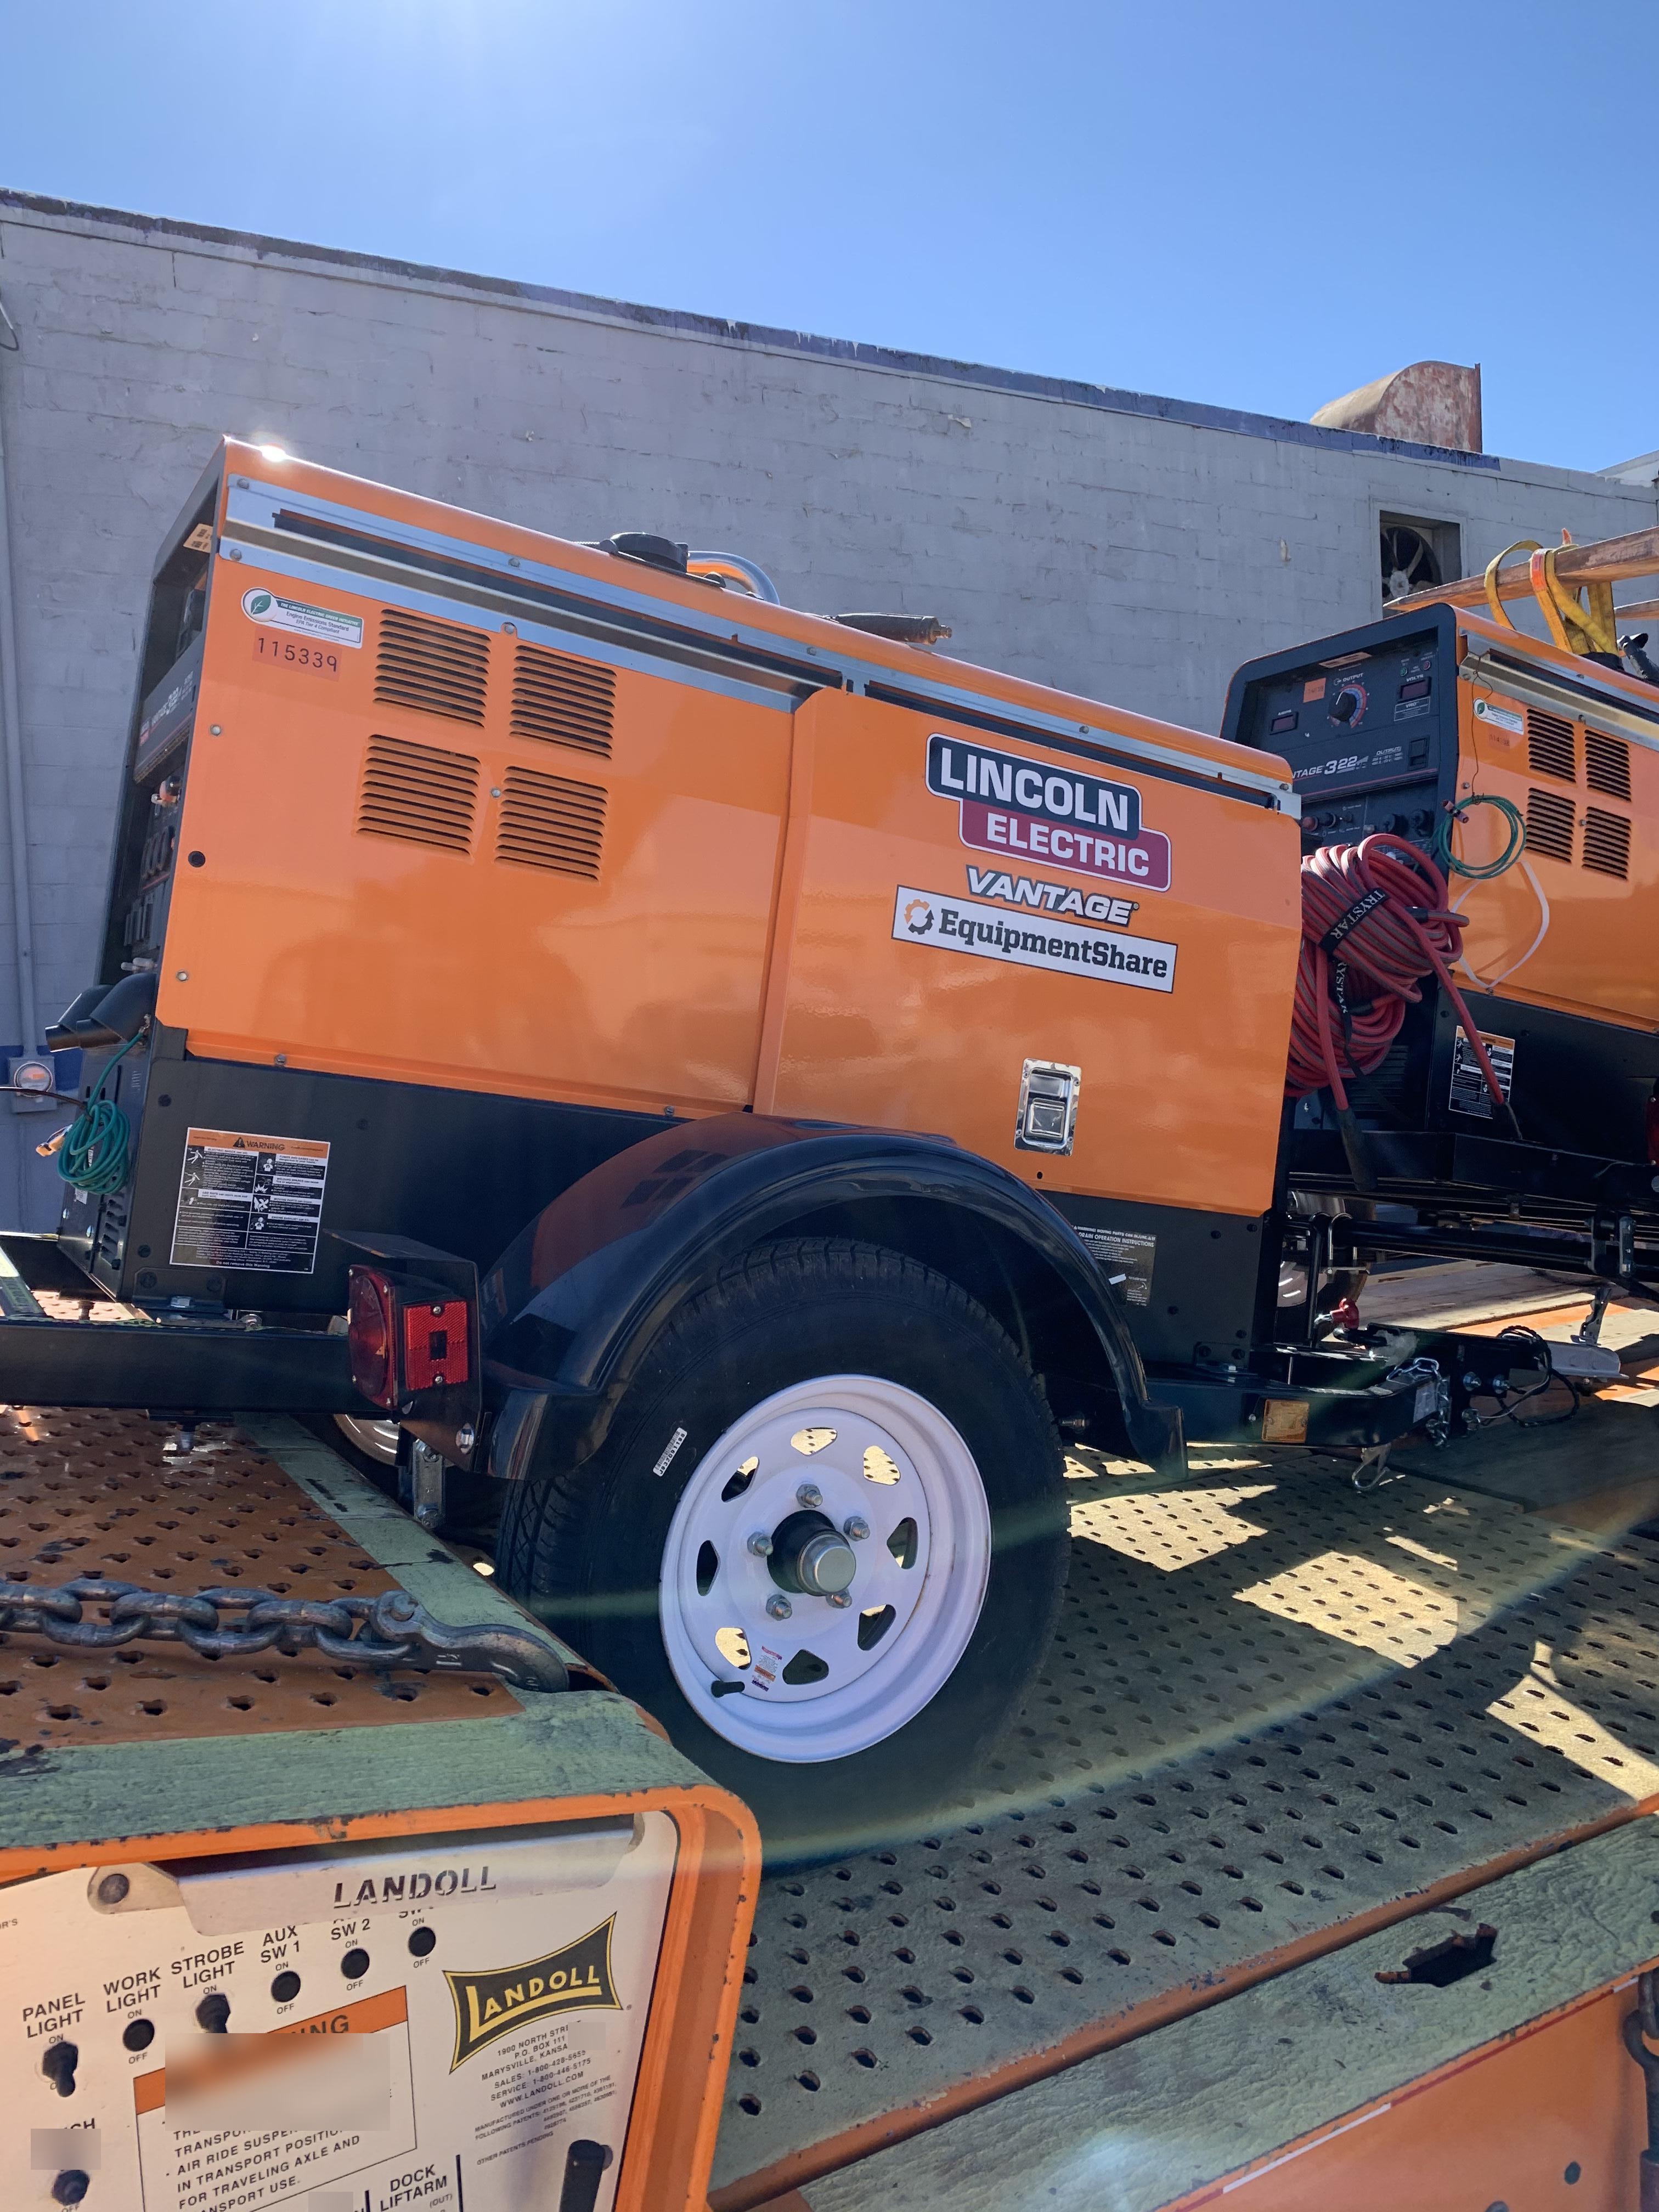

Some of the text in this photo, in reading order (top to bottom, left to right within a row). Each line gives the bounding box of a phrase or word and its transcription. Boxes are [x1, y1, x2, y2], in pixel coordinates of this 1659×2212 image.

[286, 611, 349, 631] Engine Emissions Standard
[258, 637, 337, 672] 115339
[1343, 673, 1364, 682] OUTPUT
[1406, 674, 1424, 682] VOLTS
[1293, 765, 1324, 778] NTAGE
[1324, 756, 1358, 775] 322
[940, 747, 1128, 831] LINCOLN
[987, 812, 1149, 877] ELECTRIC
[967, 867, 1134, 926] VANTAGE
[1329, 889, 1385, 939] TRYSTAR
[939, 909, 1167, 978] EquipmentShare
[247, 1141, 285, 1151] WARNING
[1094, 1234, 1120, 1243] OPERATION
[1122, 1239, 1154, 1248] INSTRUCTIONS
[334, 1866, 496, 1909] LANDOLL
[331, 1918, 371, 1940] SW 2
[413, 1917, 425, 1926] ON
[263, 1925, 298, 1946] AUX
[346, 1939, 358, 1949] ON
[171, 1941, 244, 1974] STROBE
[261, 1940, 300, 1963] SW 1
[413, 1957, 430, 1968] OFF
[183, 1961, 235, 1988] LIGHT
[275, 1962, 289, 1971] ON
[103, 1967, 161, 1996] WORK
[203, 1985, 217, 1995] ON
[347, 1979, 364, 1991] OFF
[22, 1993, 86, 2022] PANEL
[106, 1985, 161, 2013] LIGHT
[276, 2003, 295, 2015] OFF
[466, 1966, 602, 2042] LANDOLL
[27, 2009, 83, 2038] LIGHT
[127, 2009, 142, 2019] ON
[48, 2034, 64, 2044] ON
[497, 2045, 516, 2056] 1900
[519, 2033, 546, 2049] NORTH
[515, 2050, 530, 2059] P.O.
[533, 2040, 550, 2052] BOX
[128, 2052, 148, 2064] OFF
[500, 2071, 584, 2108] WWW.LANDOLL.COM
[475, 2108, 524, 2132] MANUFACTURED
[526, 2100, 546, 2112] UNDER
[549, 2095, 561, 2103] ONE
[572, 2085, 589, 2094] MORE
[600, 2075, 611, 2084] THE
[476, 2123, 511, 2140] FOLLOWING
[477, 2131, 554, 2165] OTHER PATENTS PENDING
[178, 2159, 200, 2176] AIR
[206, 2146, 238, 2165] RIDE
[178, 2130, 343, 2193] IN TRANSPORT POSITIO
[179, 2135, 360, 2209] FOR TRAVELING AXLE AND
[270, 2176, 301, 2193] USE.
[391, 2164, 436, 2192] DOCK
[380, 2175, 447, 2212] LIFTARM
[430, 2193, 453, 2208] (OUT)
